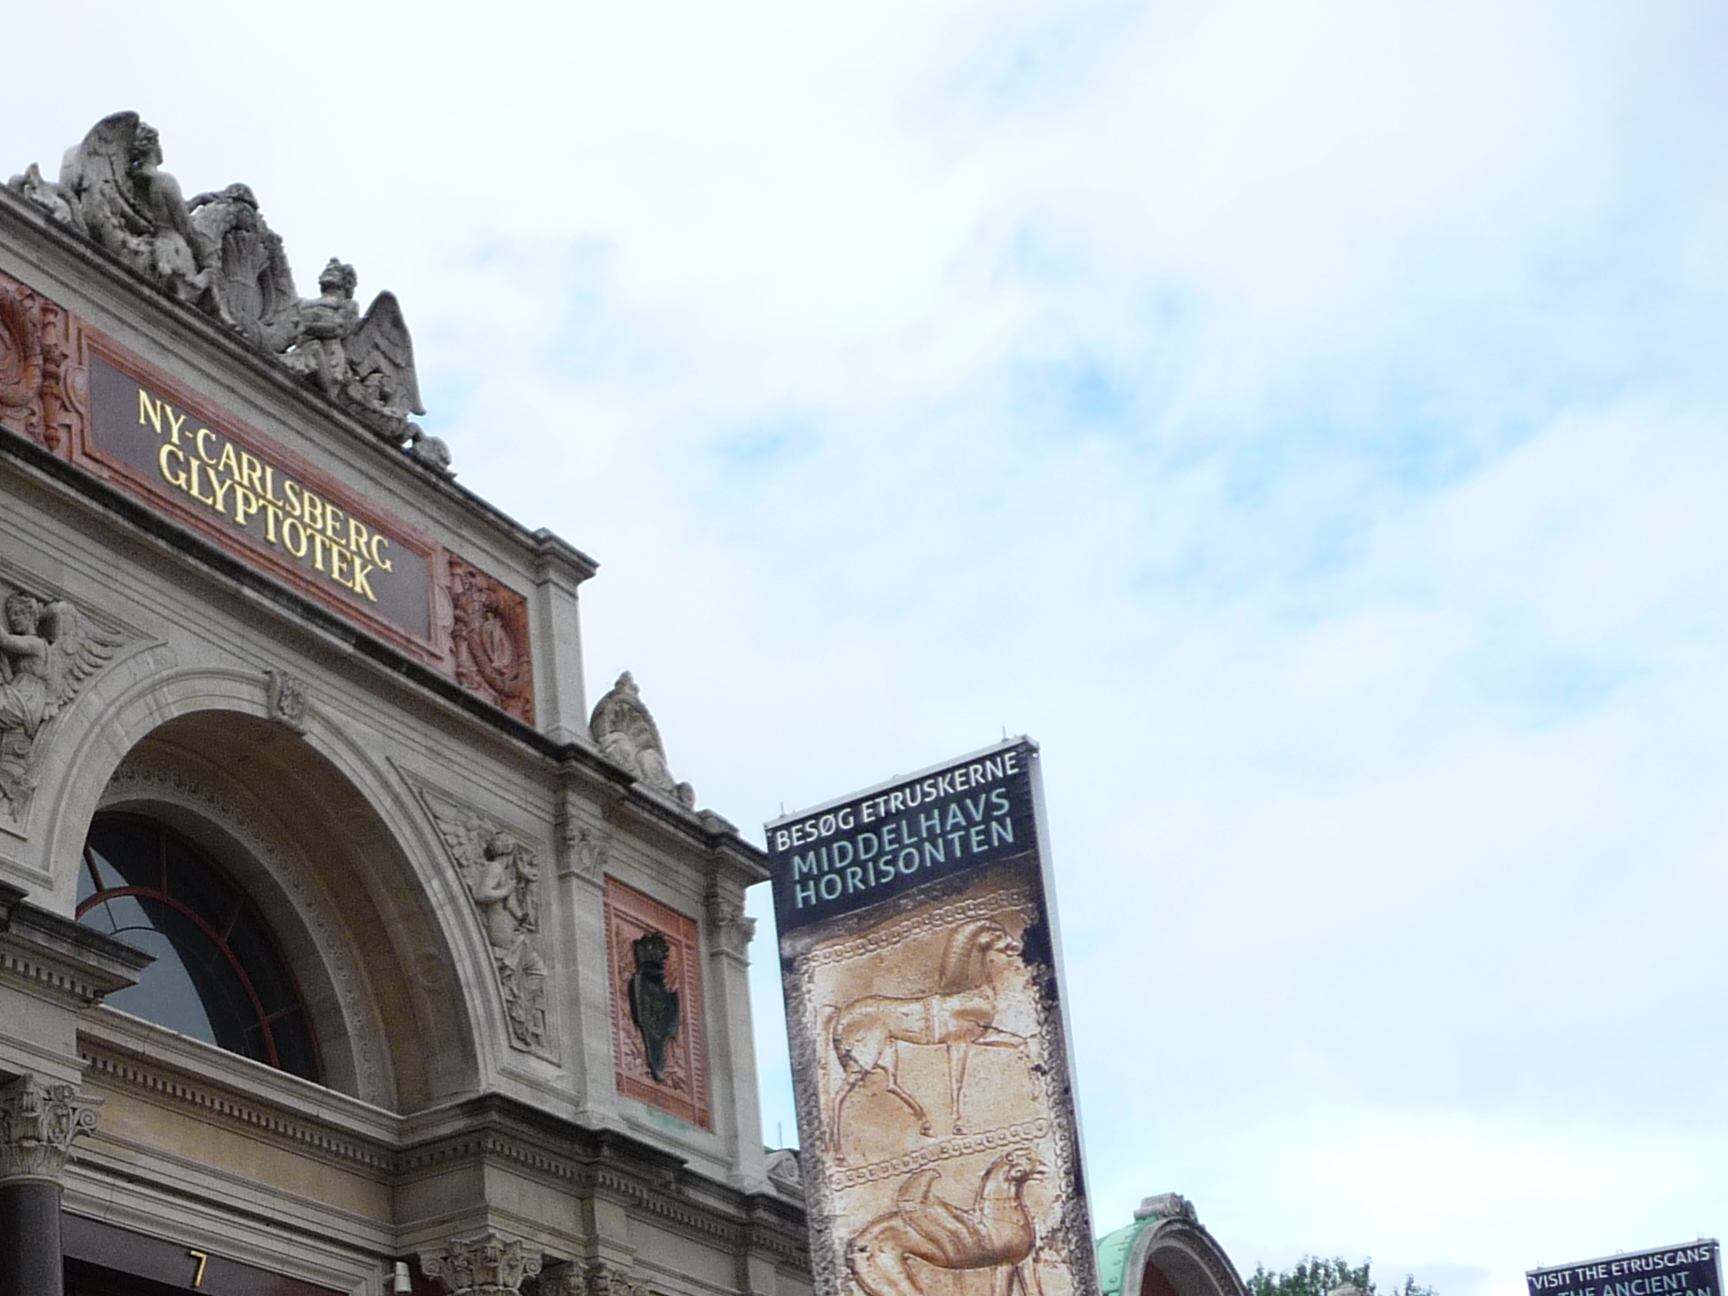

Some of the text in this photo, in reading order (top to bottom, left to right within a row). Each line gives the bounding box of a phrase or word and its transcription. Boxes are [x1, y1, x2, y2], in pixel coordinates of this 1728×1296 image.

[158, 444, 377, 602] GLYPTOTEK
[777, 752, 1020, 851] BESØG ETRUSKERNE
[793, 788, 1010, 880] MIDDELHAVS
[795, 817, 1015, 909] HORISONTEN
[190, 1250, 207, 1287] 7
[1532, 1247, 1710, 1290] VISIT THE ETRUSCANS
